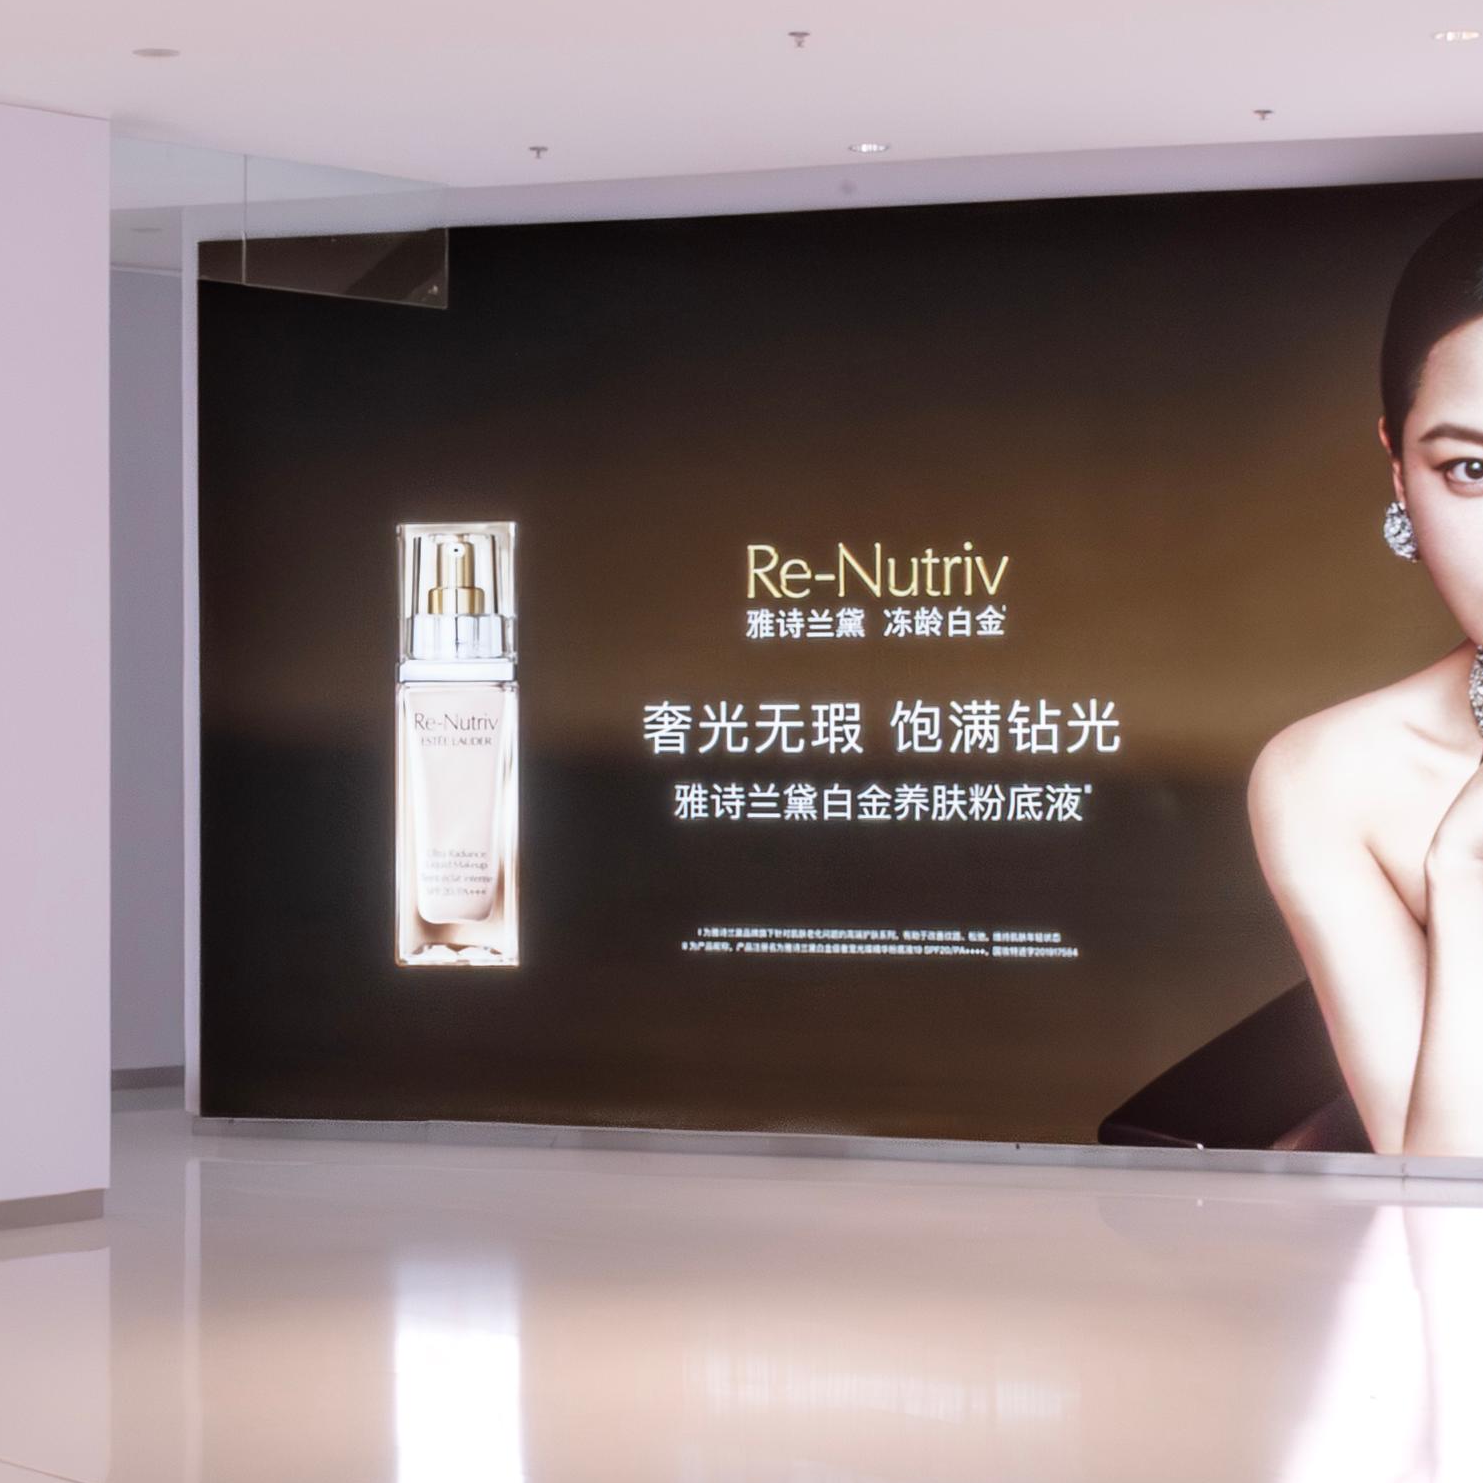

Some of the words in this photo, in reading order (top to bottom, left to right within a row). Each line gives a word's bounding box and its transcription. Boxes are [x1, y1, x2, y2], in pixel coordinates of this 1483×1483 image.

[746, 541, 1010, 599] Re-Nutriv
[745, 606, 866, 640] 雅诗兰黛
[414, 712, 499, 732] Re-Nutriv
[642, 699, 865, 755] 奢光无瑕
[889, 698, 1122, 755] 饱满钻光
